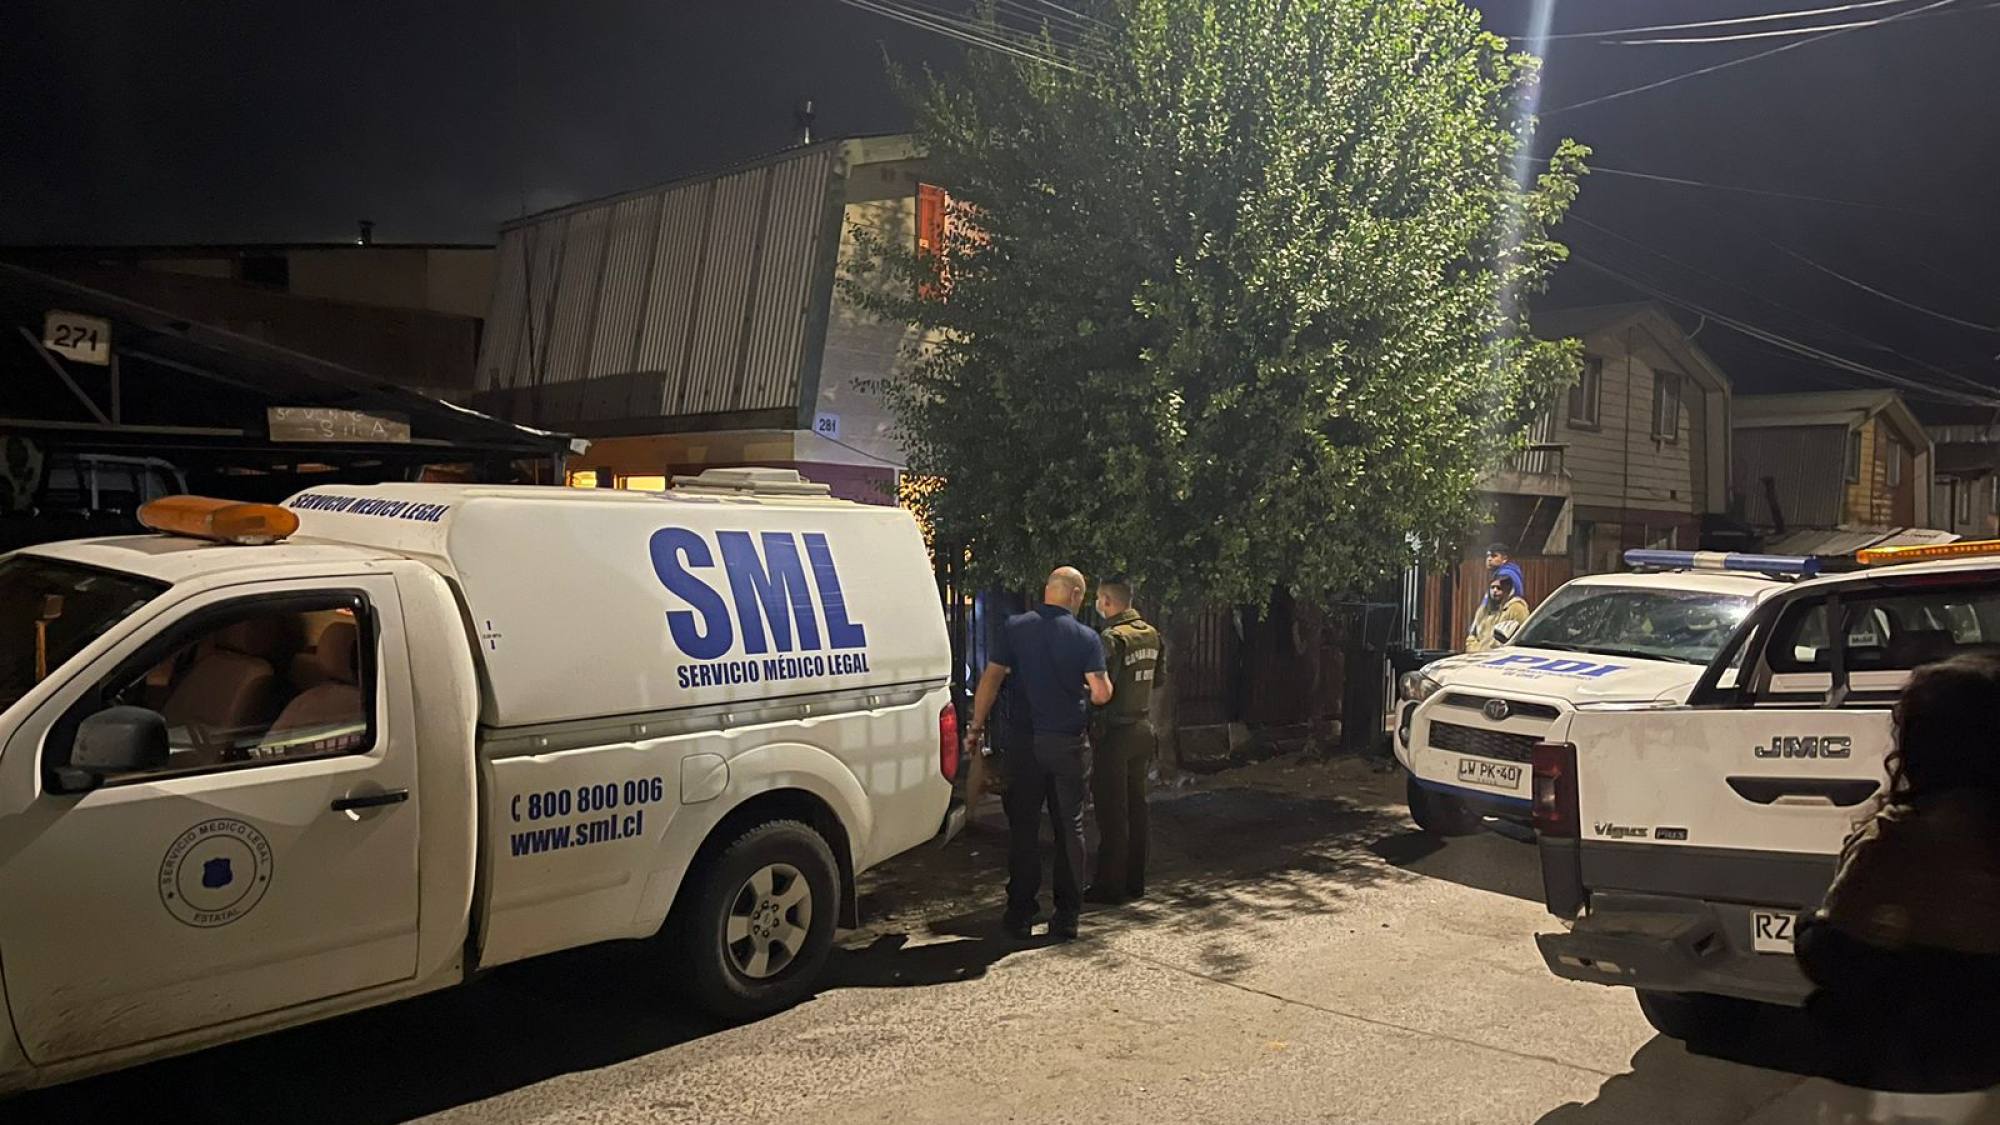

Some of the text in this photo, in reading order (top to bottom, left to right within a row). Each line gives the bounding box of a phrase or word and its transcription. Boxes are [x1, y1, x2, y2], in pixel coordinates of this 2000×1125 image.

[54, 324, 97, 352] 271
[819, 418, 836, 432] 281
[289, 493, 356, 511] SERVICIO
[400, 502, 450, 522] LEGAL
[649, 526, 867, 660] SML
[677, 653, 869, 688] SERVICIO MÉDICO LEGAL
[1483, 654, 1631, 678] PDI
[1754, 736, 1851, 759] JMC
[528, 777, 663, 820] 800 800 006
[511, 810, 643, 857] www.sml.cl
[163, 832, 197, 884] SERVICIO
[1756, 914, 1791, 940] RZ
